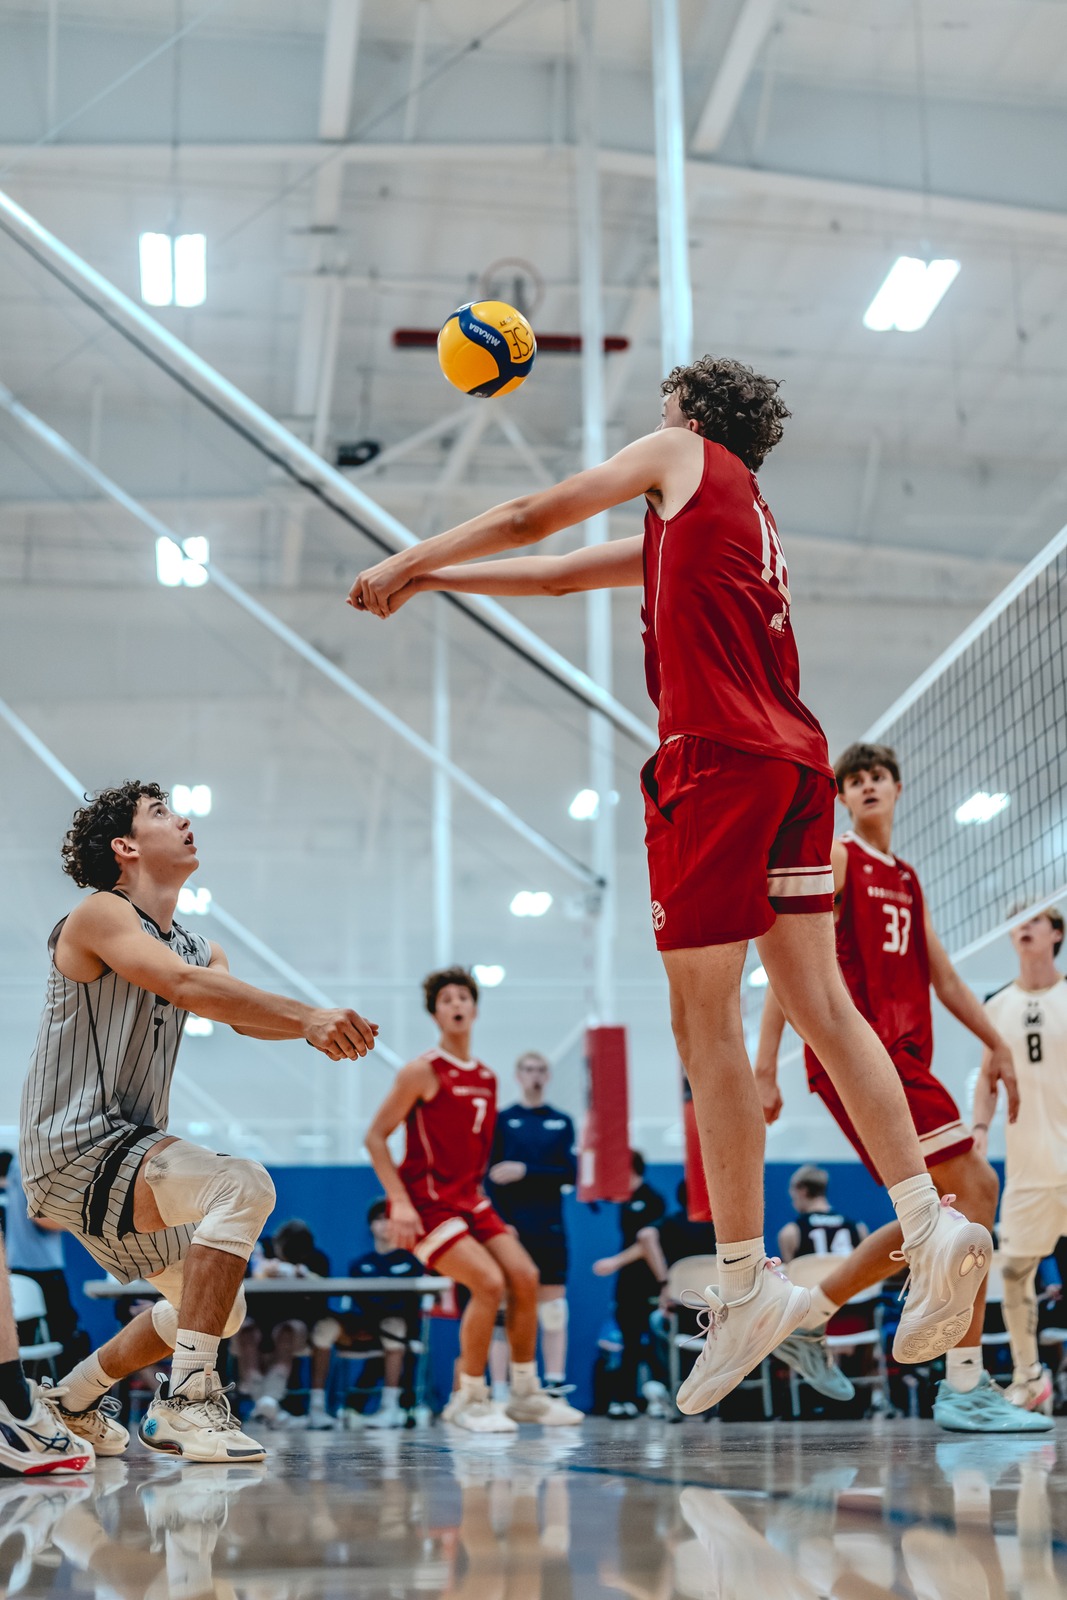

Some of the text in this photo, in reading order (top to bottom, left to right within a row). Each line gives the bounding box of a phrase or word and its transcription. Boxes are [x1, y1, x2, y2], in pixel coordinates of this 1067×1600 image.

[1027, 1033, 1042, 1063] 8
[471, 1097, 487, 1134] 7
[808, 1227, 853, 1258] 14
